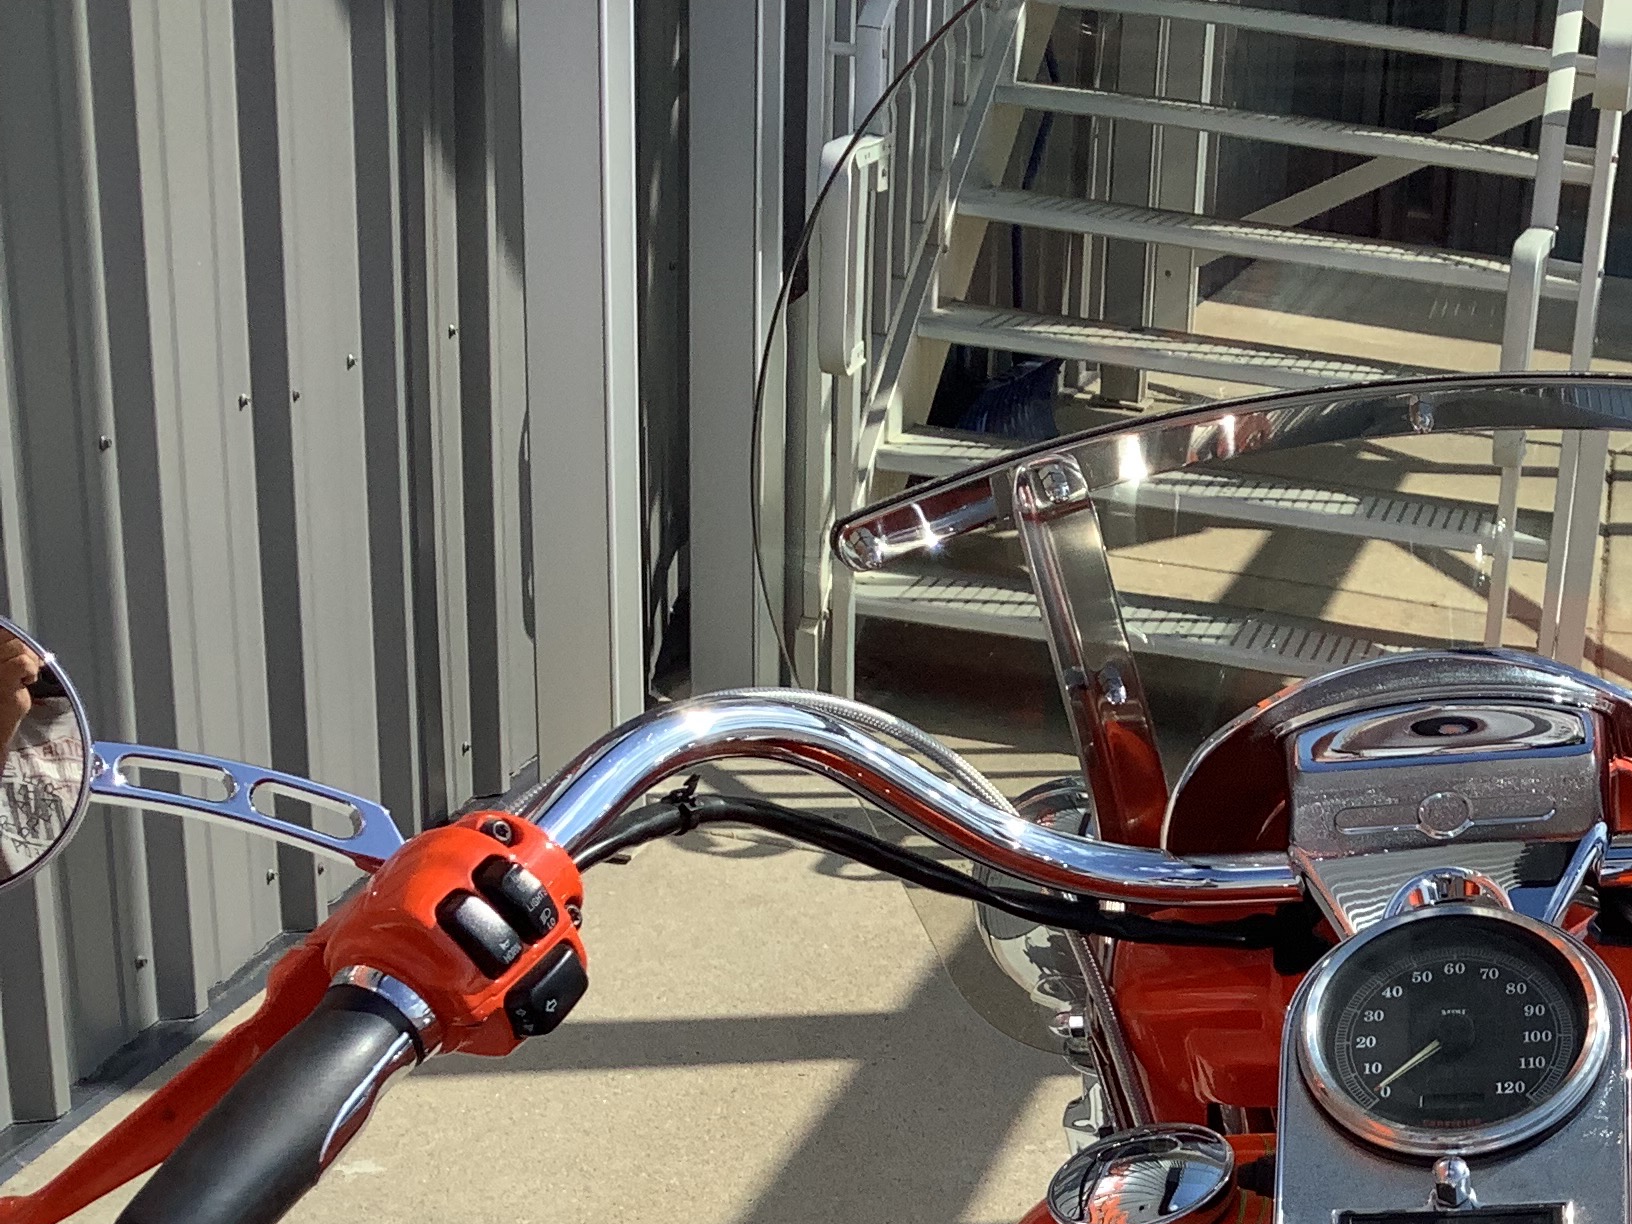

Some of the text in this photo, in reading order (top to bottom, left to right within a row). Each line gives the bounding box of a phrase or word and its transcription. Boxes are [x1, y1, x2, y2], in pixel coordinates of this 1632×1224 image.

[1444, 963, 1465, 975] 60
[1479, 967, 1499, 980] 70
[1411, 971, 1432, 983] 50
[1381, 986, 1403, 998] 40
[1505, 982, 1527, 995] 80
[1364, 1010, 1384, 1022] 30
[1523, 1004, 1545, 1017] 90
[1356, 1036, 1376, 1049] 20
[1522, 1030, 1552, 1043] 100
[1364, 1062, 1382, 1074] 10
[1518, 1057, 1546, 1069] 110
[1380, 1086, 1391, 1098] 0
[1495, 1081, 1525, 1095] 120
